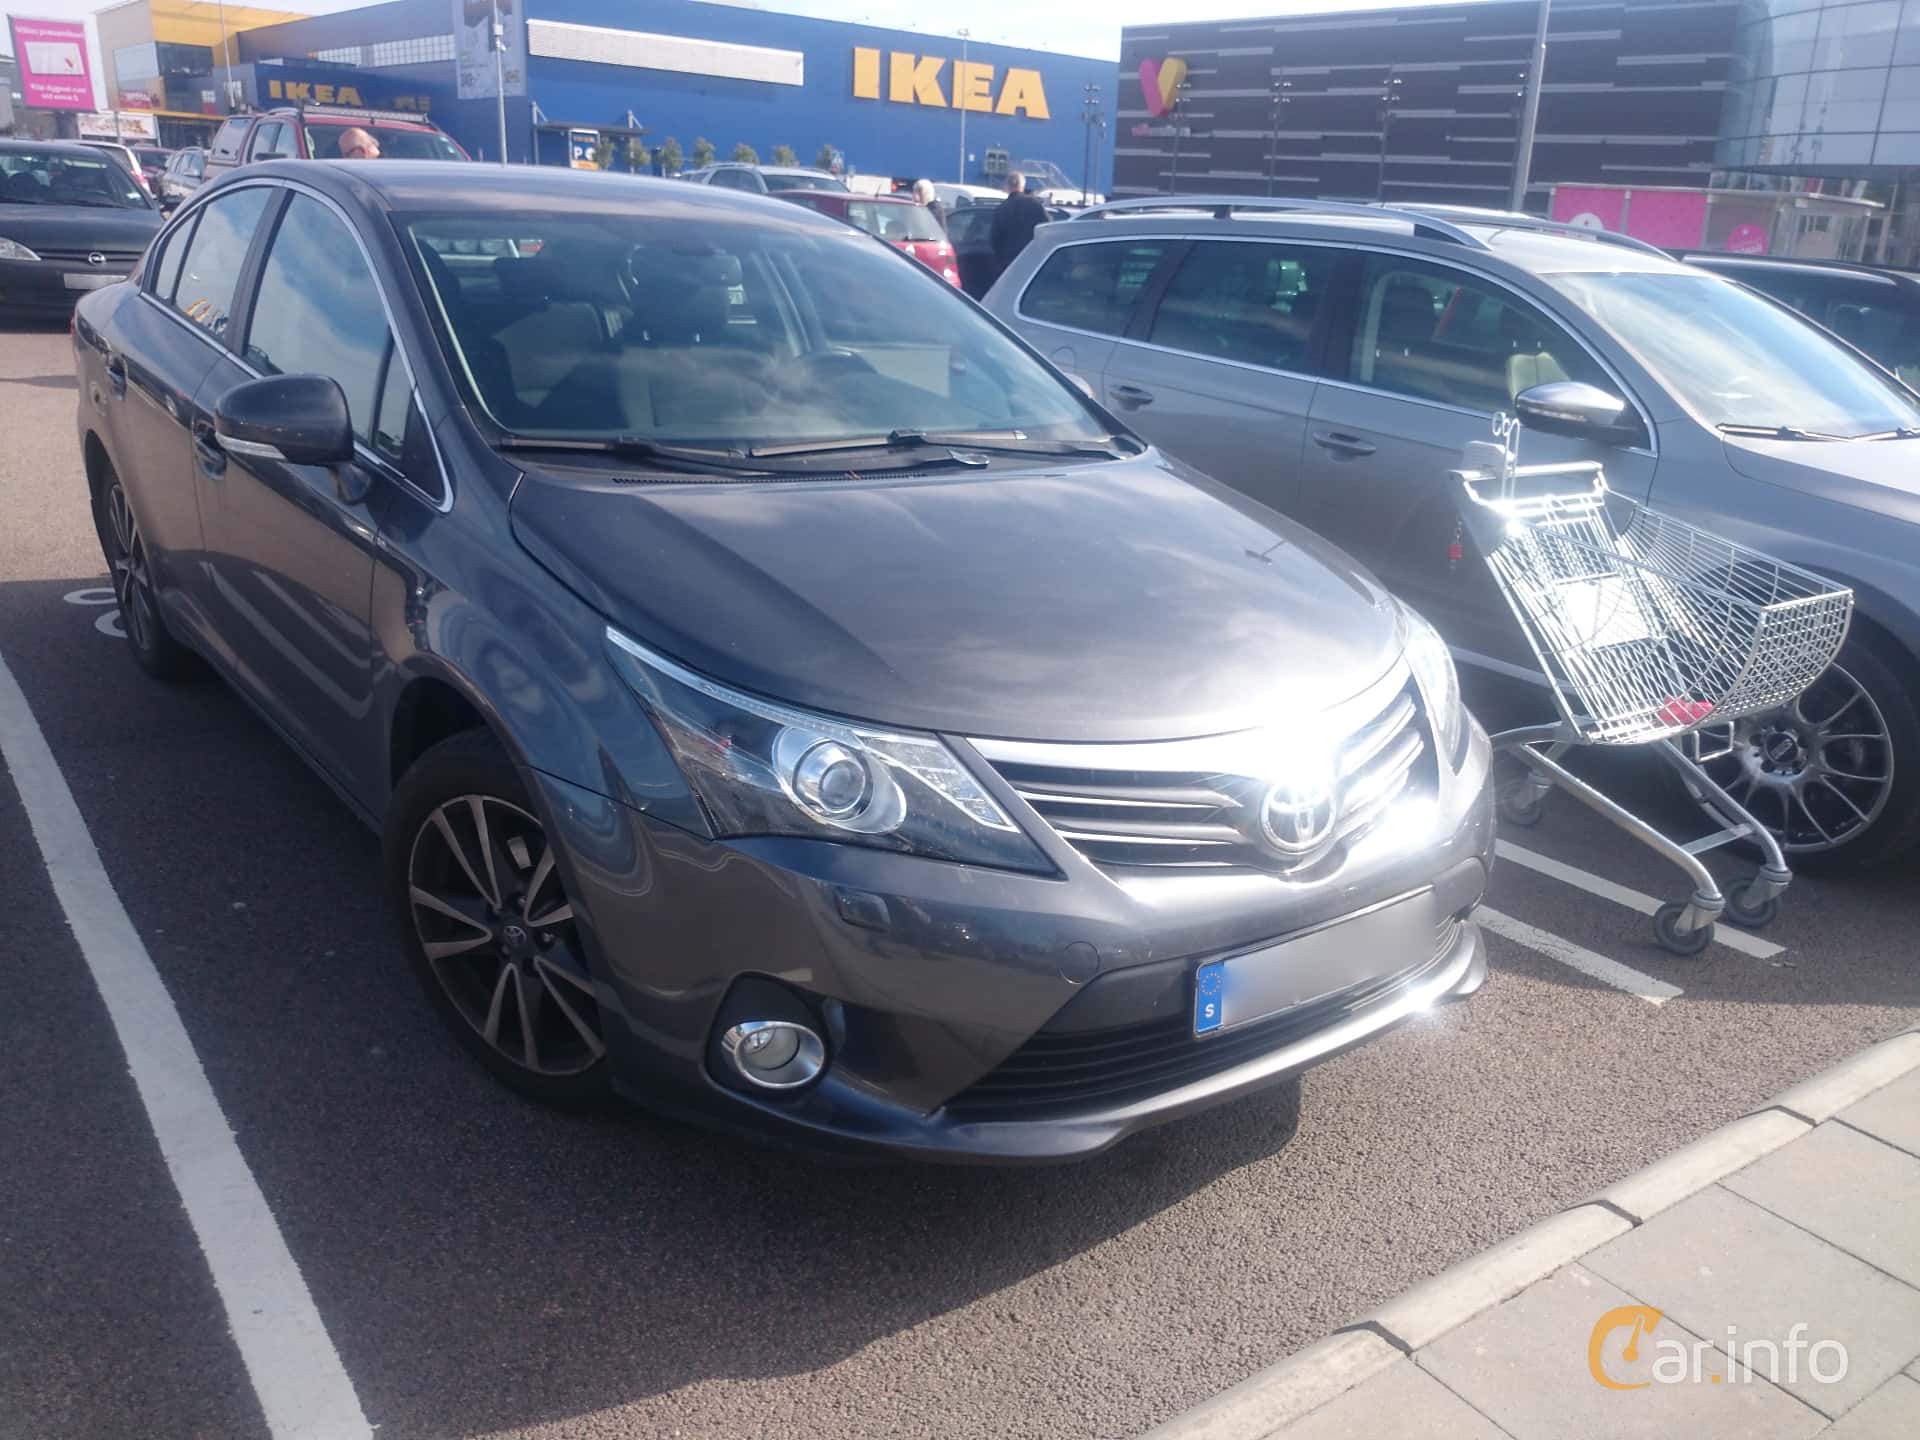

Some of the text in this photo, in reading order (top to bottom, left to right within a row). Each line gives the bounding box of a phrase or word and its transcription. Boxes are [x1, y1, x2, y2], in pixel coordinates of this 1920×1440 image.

[269, 80, 362, 105] IKEA
[853, 46, 1050, 119] IKEA
[1205, 1003, 1215, 1018] S
